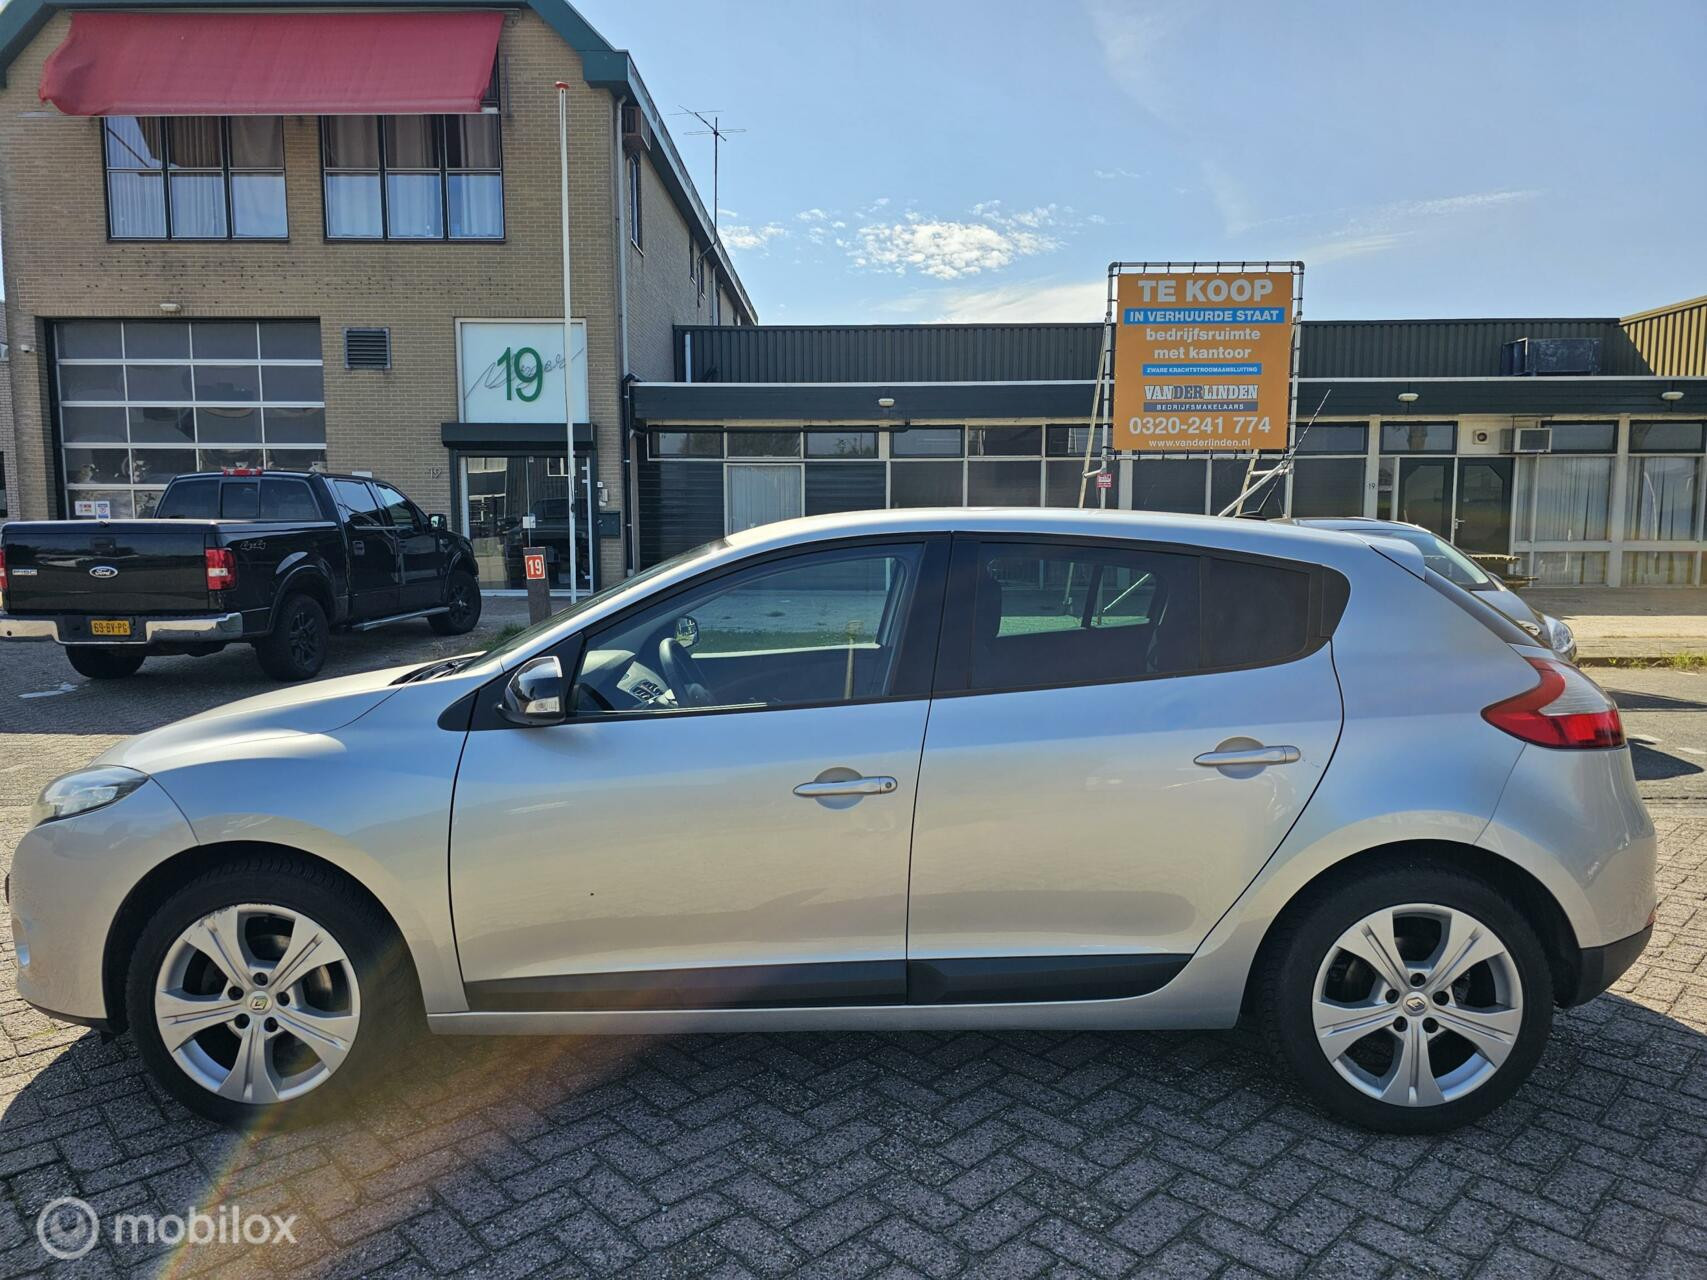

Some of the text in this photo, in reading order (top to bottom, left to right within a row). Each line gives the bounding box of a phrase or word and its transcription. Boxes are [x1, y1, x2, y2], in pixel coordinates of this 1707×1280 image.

[1138, 279, 1273, 302] TE KOOP
[1130, 310, 1279, 322] IN VERHUURDE STAAT
[1146, 328, 1261, 343] bedrijfsruimte
[1154, 347, 1252, 359] met kantoor
[497, 347, 543, 402] 19
[1156, 403, 1244, 411] BEDRIJFSMAKELAARS
[1129, 416, 1271, 434] 0320-241 774
[1149, 438, 1251, 448] www.vanderlinden.nl
[528, 560, 543, 575] 19
